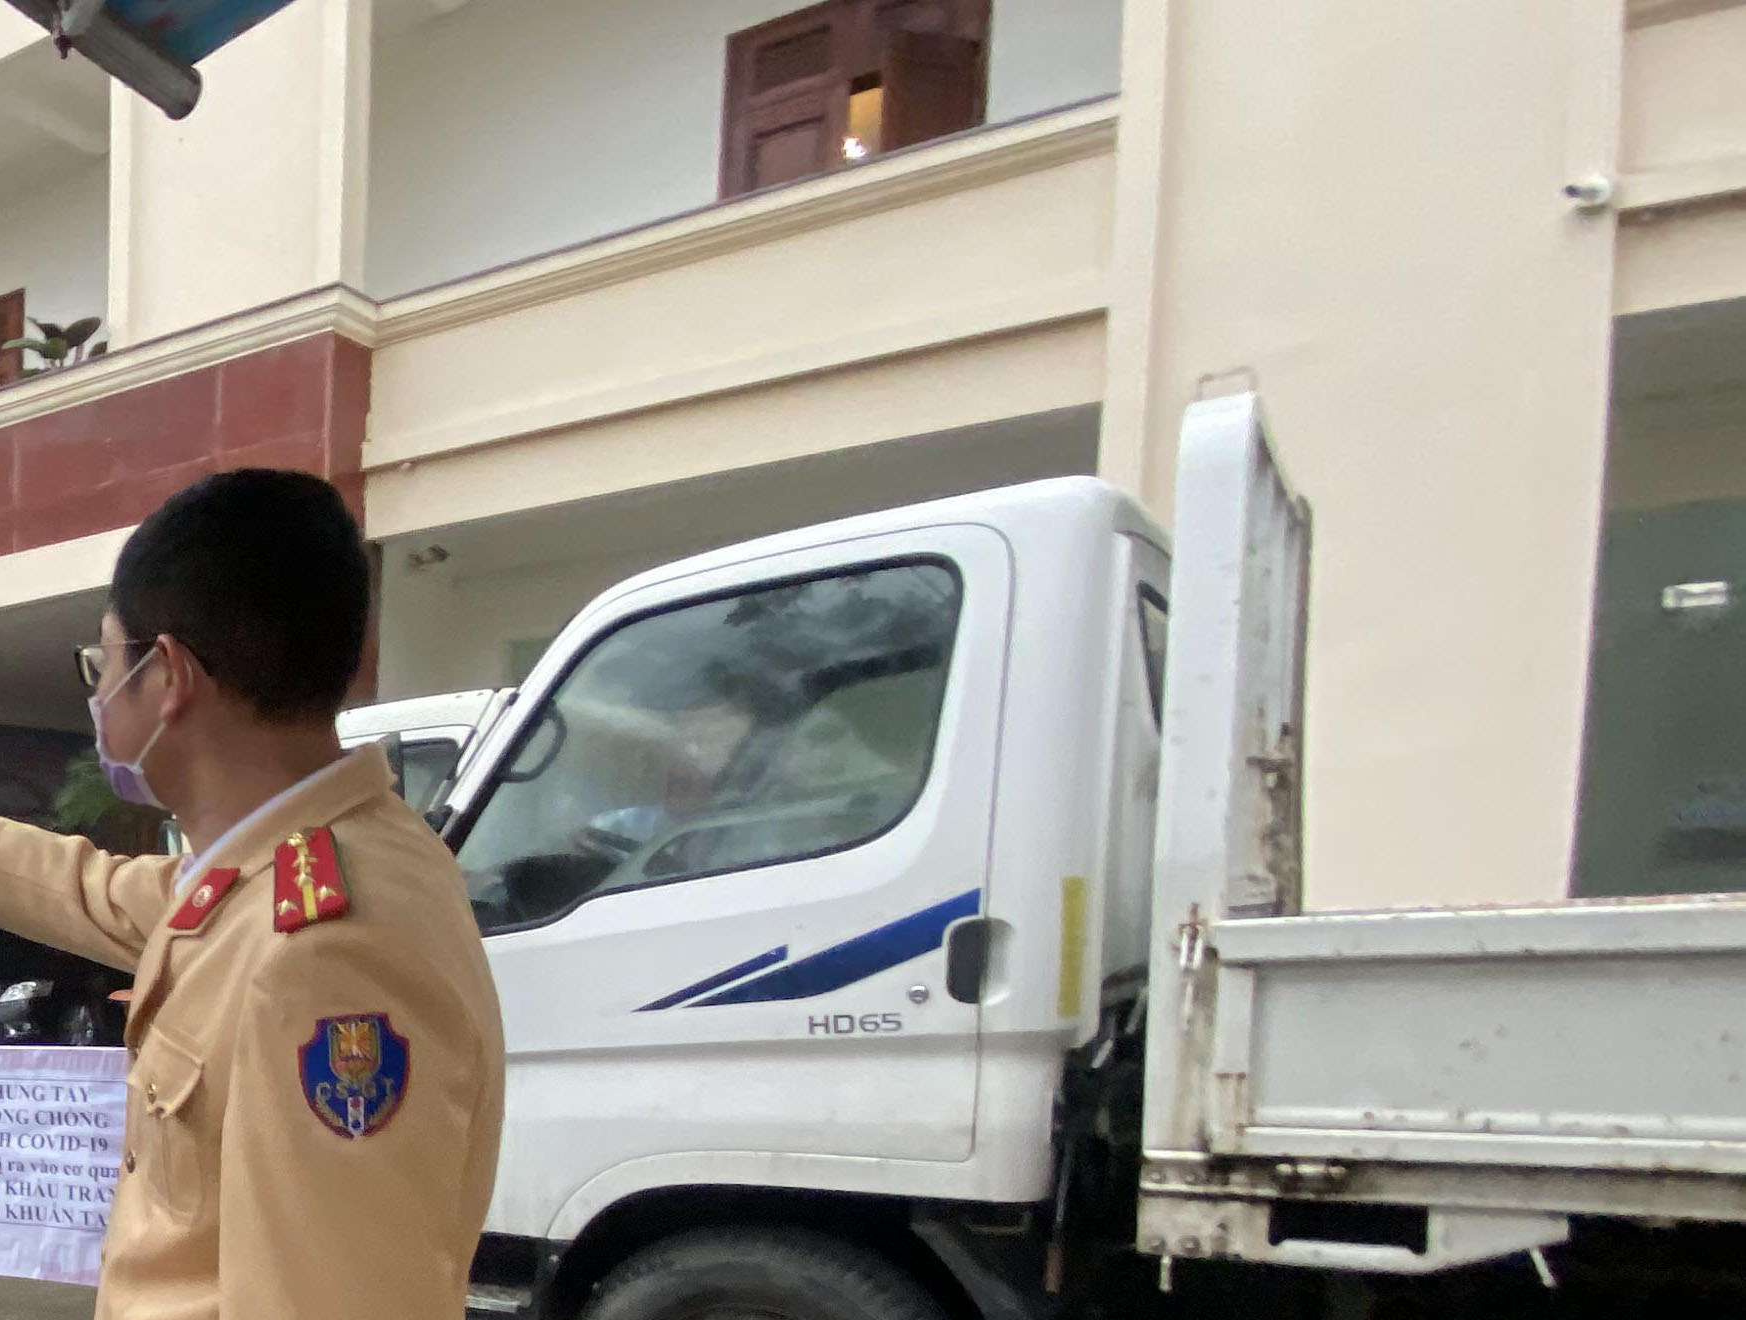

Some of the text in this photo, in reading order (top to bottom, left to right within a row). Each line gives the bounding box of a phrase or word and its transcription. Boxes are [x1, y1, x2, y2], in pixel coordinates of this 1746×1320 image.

[808, 1012, 902, 1035] HD65
[53, 1086, 90, 1103] TAY
[17, 1132, 109, 1152] COVID-19
[8, 1160, 25, 1173] ra
[88, 1165, 120, 1182] qua
[80, 1209, 107, 1227] TA
